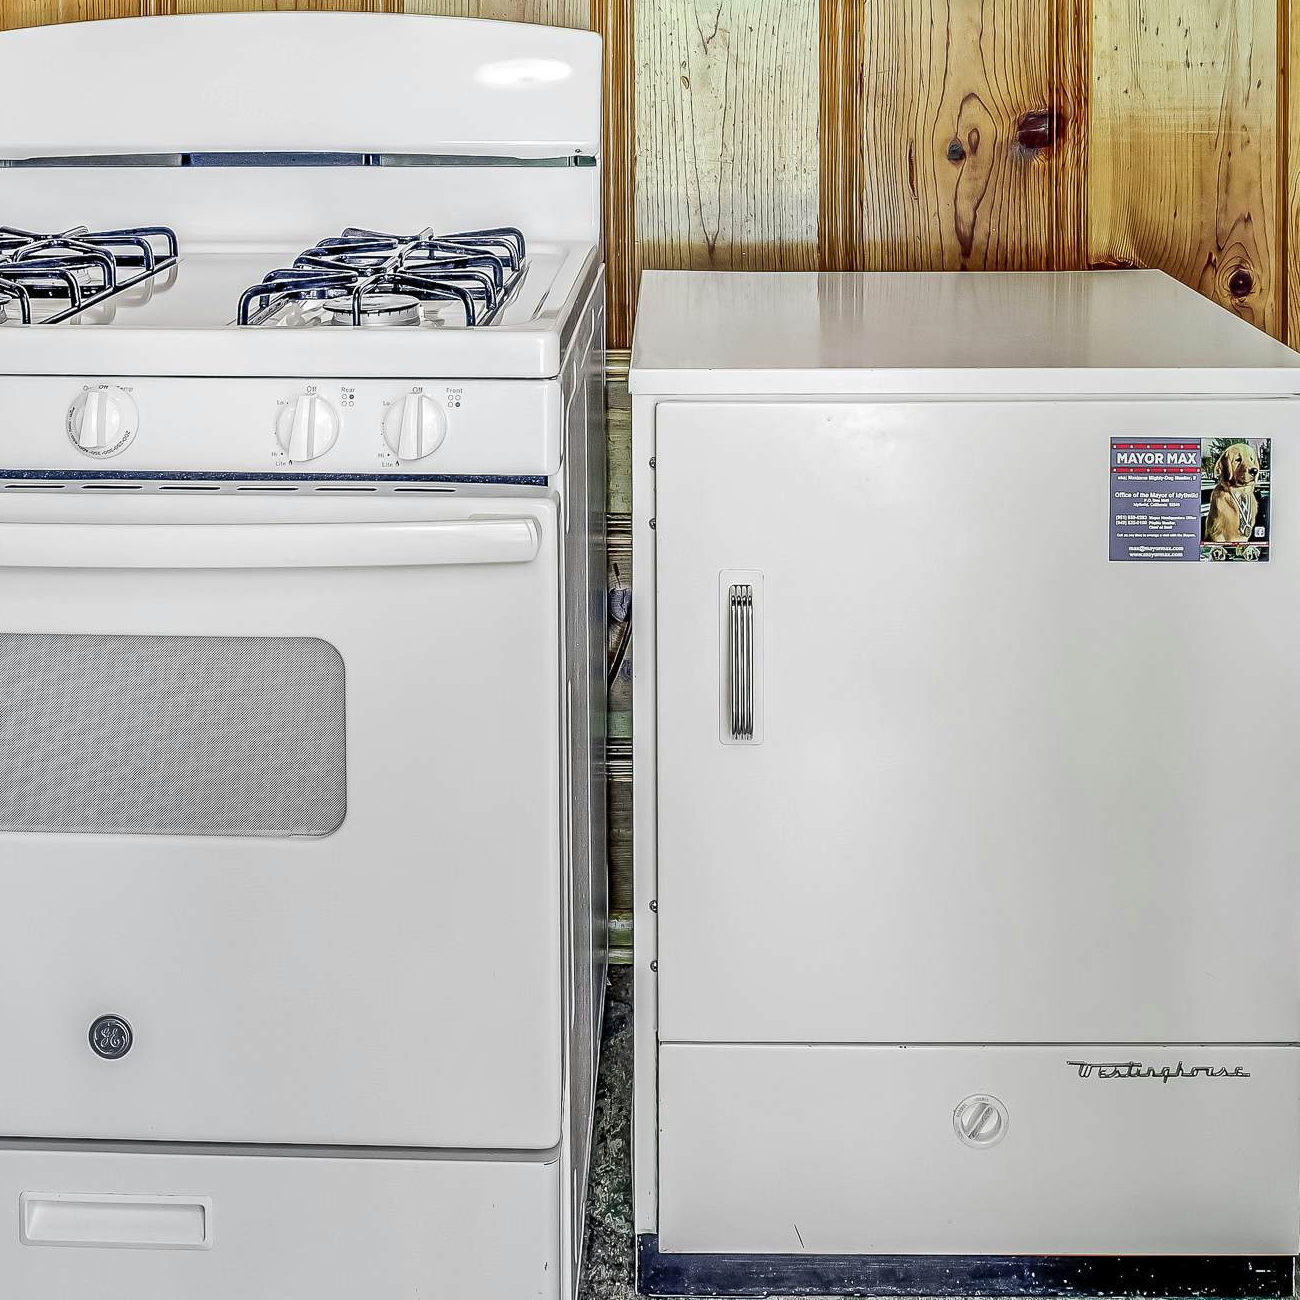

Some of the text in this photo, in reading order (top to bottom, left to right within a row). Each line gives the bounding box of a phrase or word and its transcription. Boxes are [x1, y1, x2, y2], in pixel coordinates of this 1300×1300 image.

[1116, 452, 1197, 464] MAYOR MAX
[1067, 1061, 1250, 1083] Westinghouse
